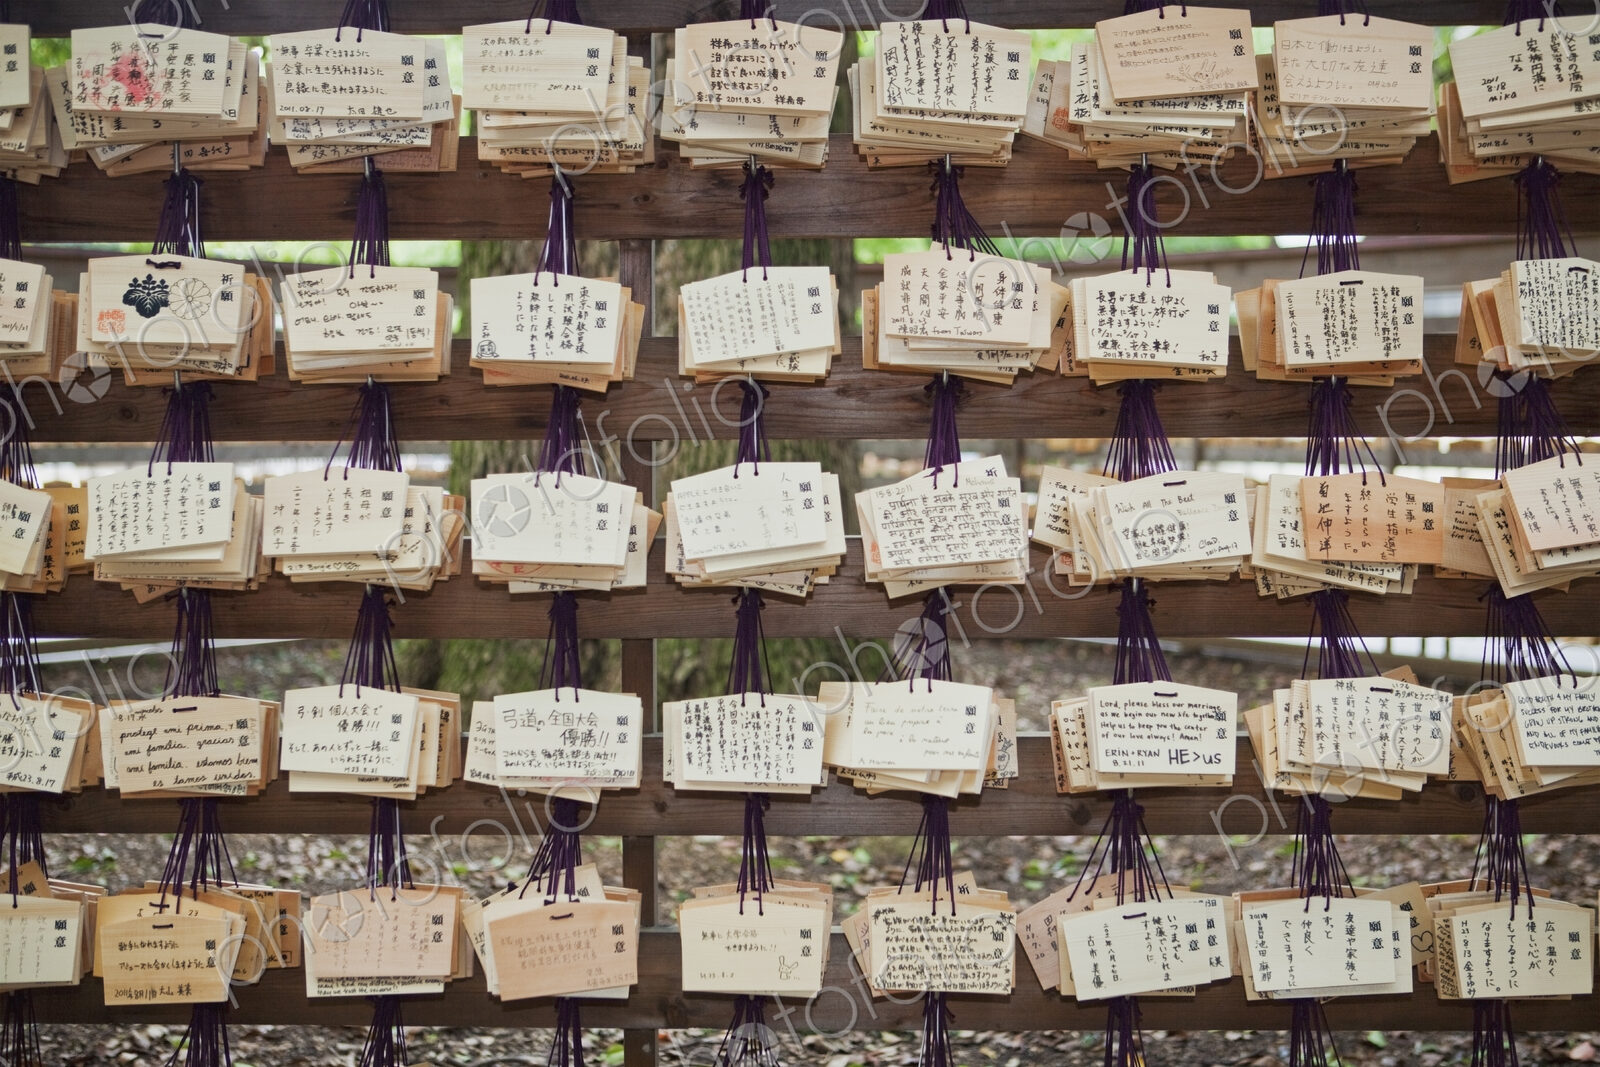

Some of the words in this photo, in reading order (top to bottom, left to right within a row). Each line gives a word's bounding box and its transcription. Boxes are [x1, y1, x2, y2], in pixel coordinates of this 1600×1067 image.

[4, 43, 19, 72] 願意
[1229, 29, 1245, 57] 願意
[202, 53, 215, 80] 願意
[401, 55, 414, 83] 願意
[586, 48, 599, 77] 願意
[814, 51, 827, 78] 願意
[1007, 52, 1019, 80] 願意
[1409, 45, 1422, 74] 願意
[14, 280, 29, 308] 願意
[221, 273, 235, 302] 祈願
[808, 287, 822, 315] 願意
[919, 268, 931, 318] 天天開心
[937, 268, 949, 320] 全家平安
[1011, 281, 1023, 310] 願意
[413, 289, 426, 316] 願意
[594, 301, 607, 328] 願意
[1402, 296, 1414, 325] 願意
[1208, 304, 1219, 332] 願意
[208, 481, 221, 509] 願意
[342, 488, 353, 523] 長生き
[359, 488, 372, 520] 祖母が
[380, 490, 394, 518] 願意
[799, 482, 814, 510] 願意
[1225, 493, 1239, 522] 願意
[12, 511, 32, 540] 願意
[67, 504, 80, 531] 願意
[596, 503, 608, 530] 願意
[999, 497, 1010, 526] 願意
[1405, 492, 1416, 535] 無事に
[1422, 502, 1435, 531] 願意
[548, 710, 599, 727] 全国大会
[1124, 698, 1148, 710] please
[1152, 699, 1170, 708] bless
[236, 718, 250, 747] 願意
[389, 714, 402, 742] 願意
[617, 716, 628, 744] 願意
[965, 705, 976, 734] 願意
[1430, 711, 1441, 739] 願意
[49, 730, 65, 757] 願意
[802, 722, 814, 750] 願意
[1137, 749, 1160, 757] RYAN
[54, 919, 67, 948] 願意
[432, 914, 443, 943] 願意
[612, 924, 625, 953] 願意
[800, 928, 811, 957] 願意
[1166, 915, 1184, 963] いつまでも、
[1185, 923, 1200, 952] 願意
[1301, 920, 1314, 955] 仲良く
[1323, 916, 1334, 940] ずっと
[1369, 921, 1384, 950] 願意
[205, 939, 216, 969] 願意
[1282, 919, 1296, 987] できますように
[1506, 922, 1518, 988] もてるように
[1526, 923, 1541, 971] 優しい心が
[1544, 920, 1557, 976] 広く温かく
[1569, 931, 1581, 960] 願意
